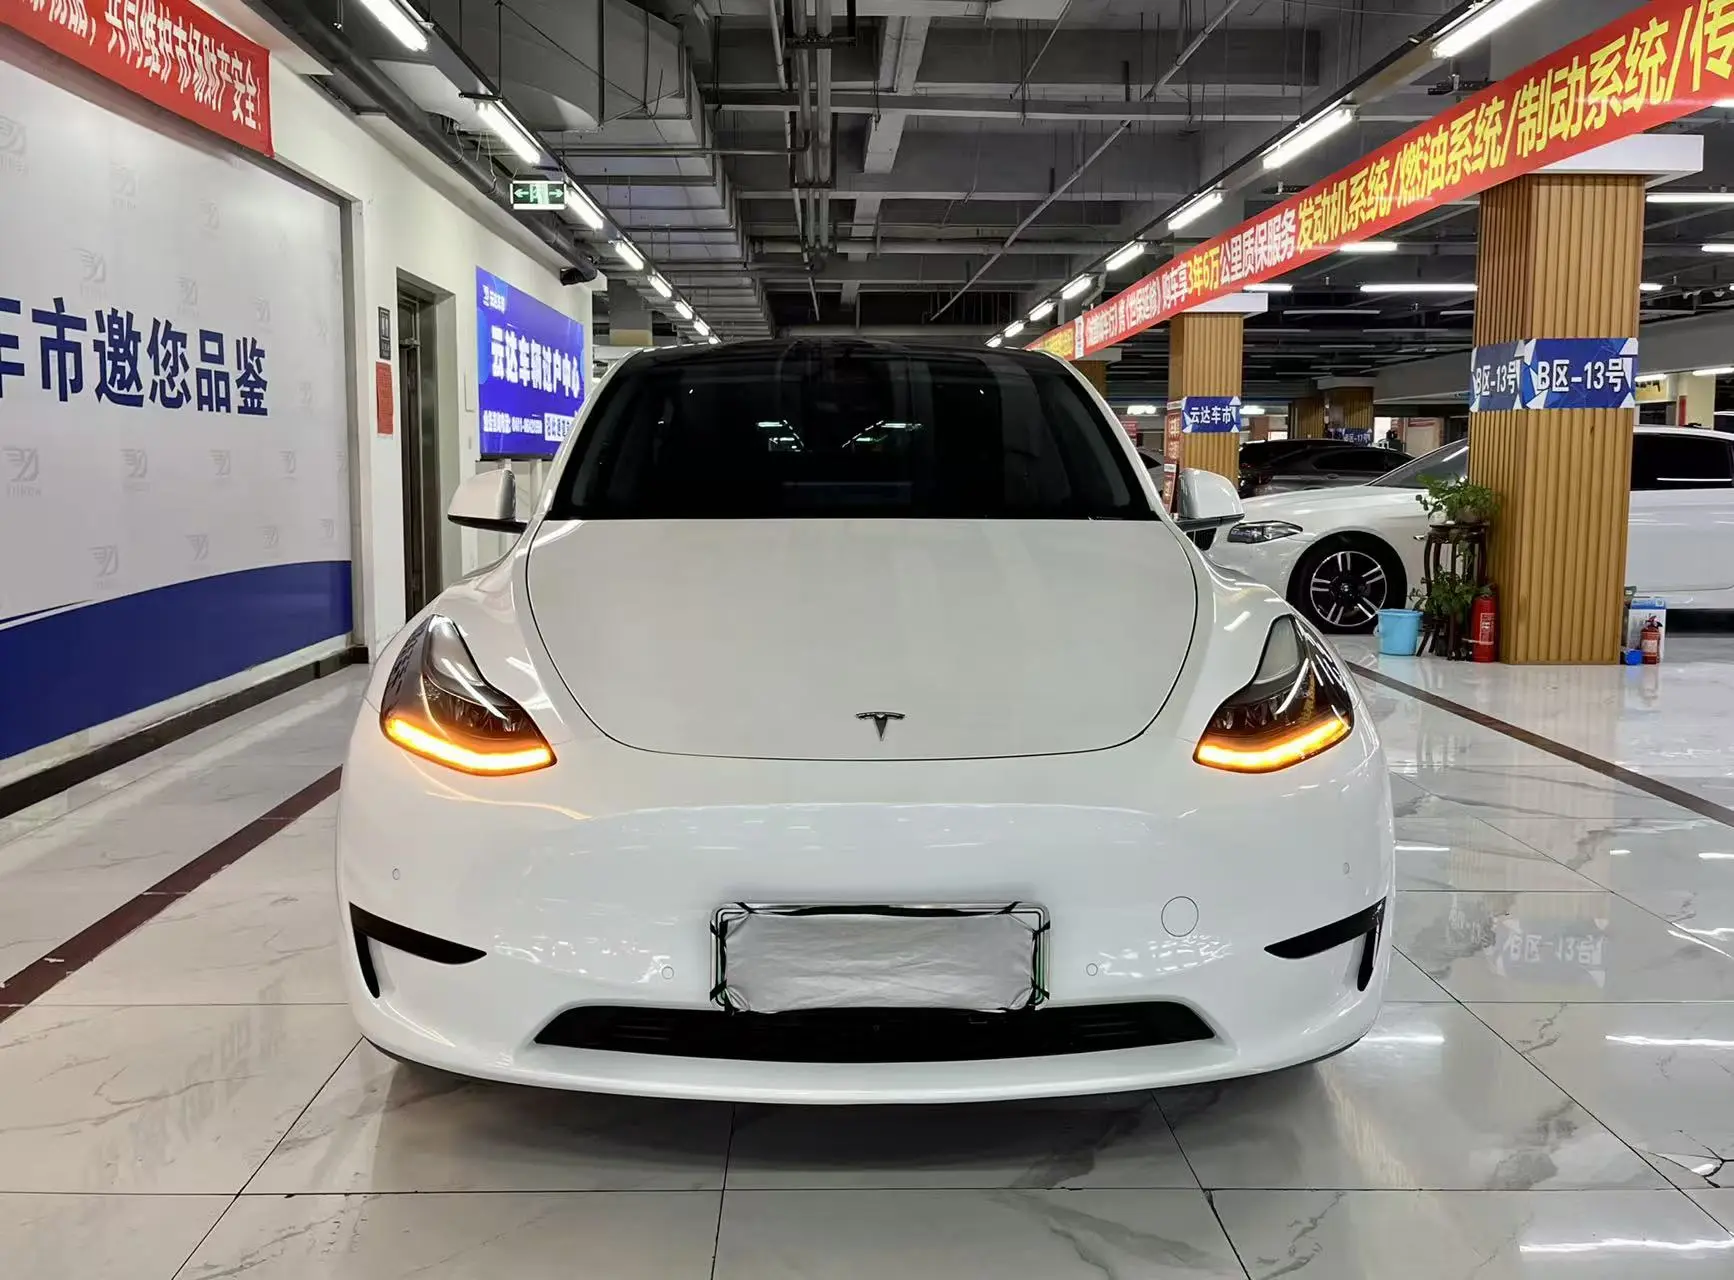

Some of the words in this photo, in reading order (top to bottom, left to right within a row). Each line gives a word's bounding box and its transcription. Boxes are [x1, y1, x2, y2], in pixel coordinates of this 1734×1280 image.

[1474, 363, 1518, 396] B区-13号
[1536, 357, 1626, 393] B区-13号
[1189, 406, 1231, 425] 云达车市
